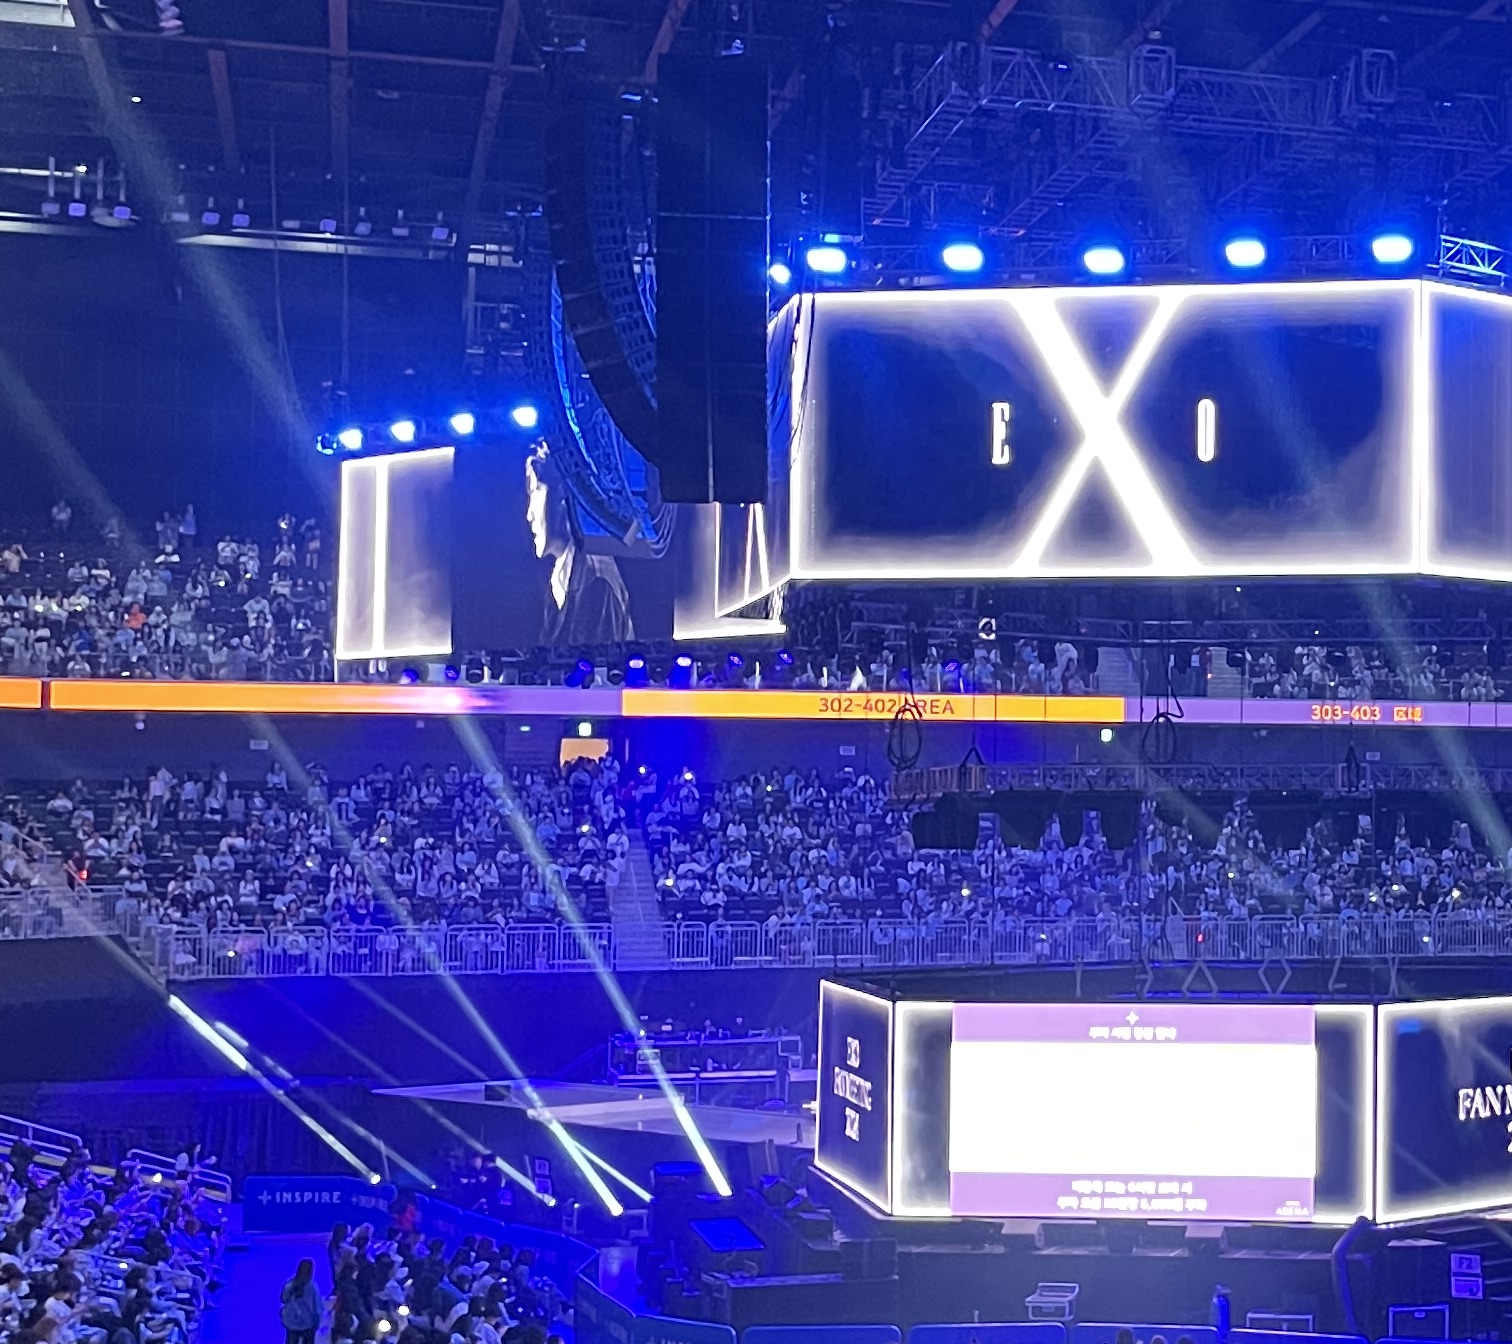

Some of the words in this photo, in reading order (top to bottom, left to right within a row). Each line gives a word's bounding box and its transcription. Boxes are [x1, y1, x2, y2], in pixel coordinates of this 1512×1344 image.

[818, 697, 897, 713] 302-402
[1311, 704, 1381, 721] 303-403
[1458, 1085, 1504, 1121] FAN
[275, 1191, 342, 1204] INSPIRE
